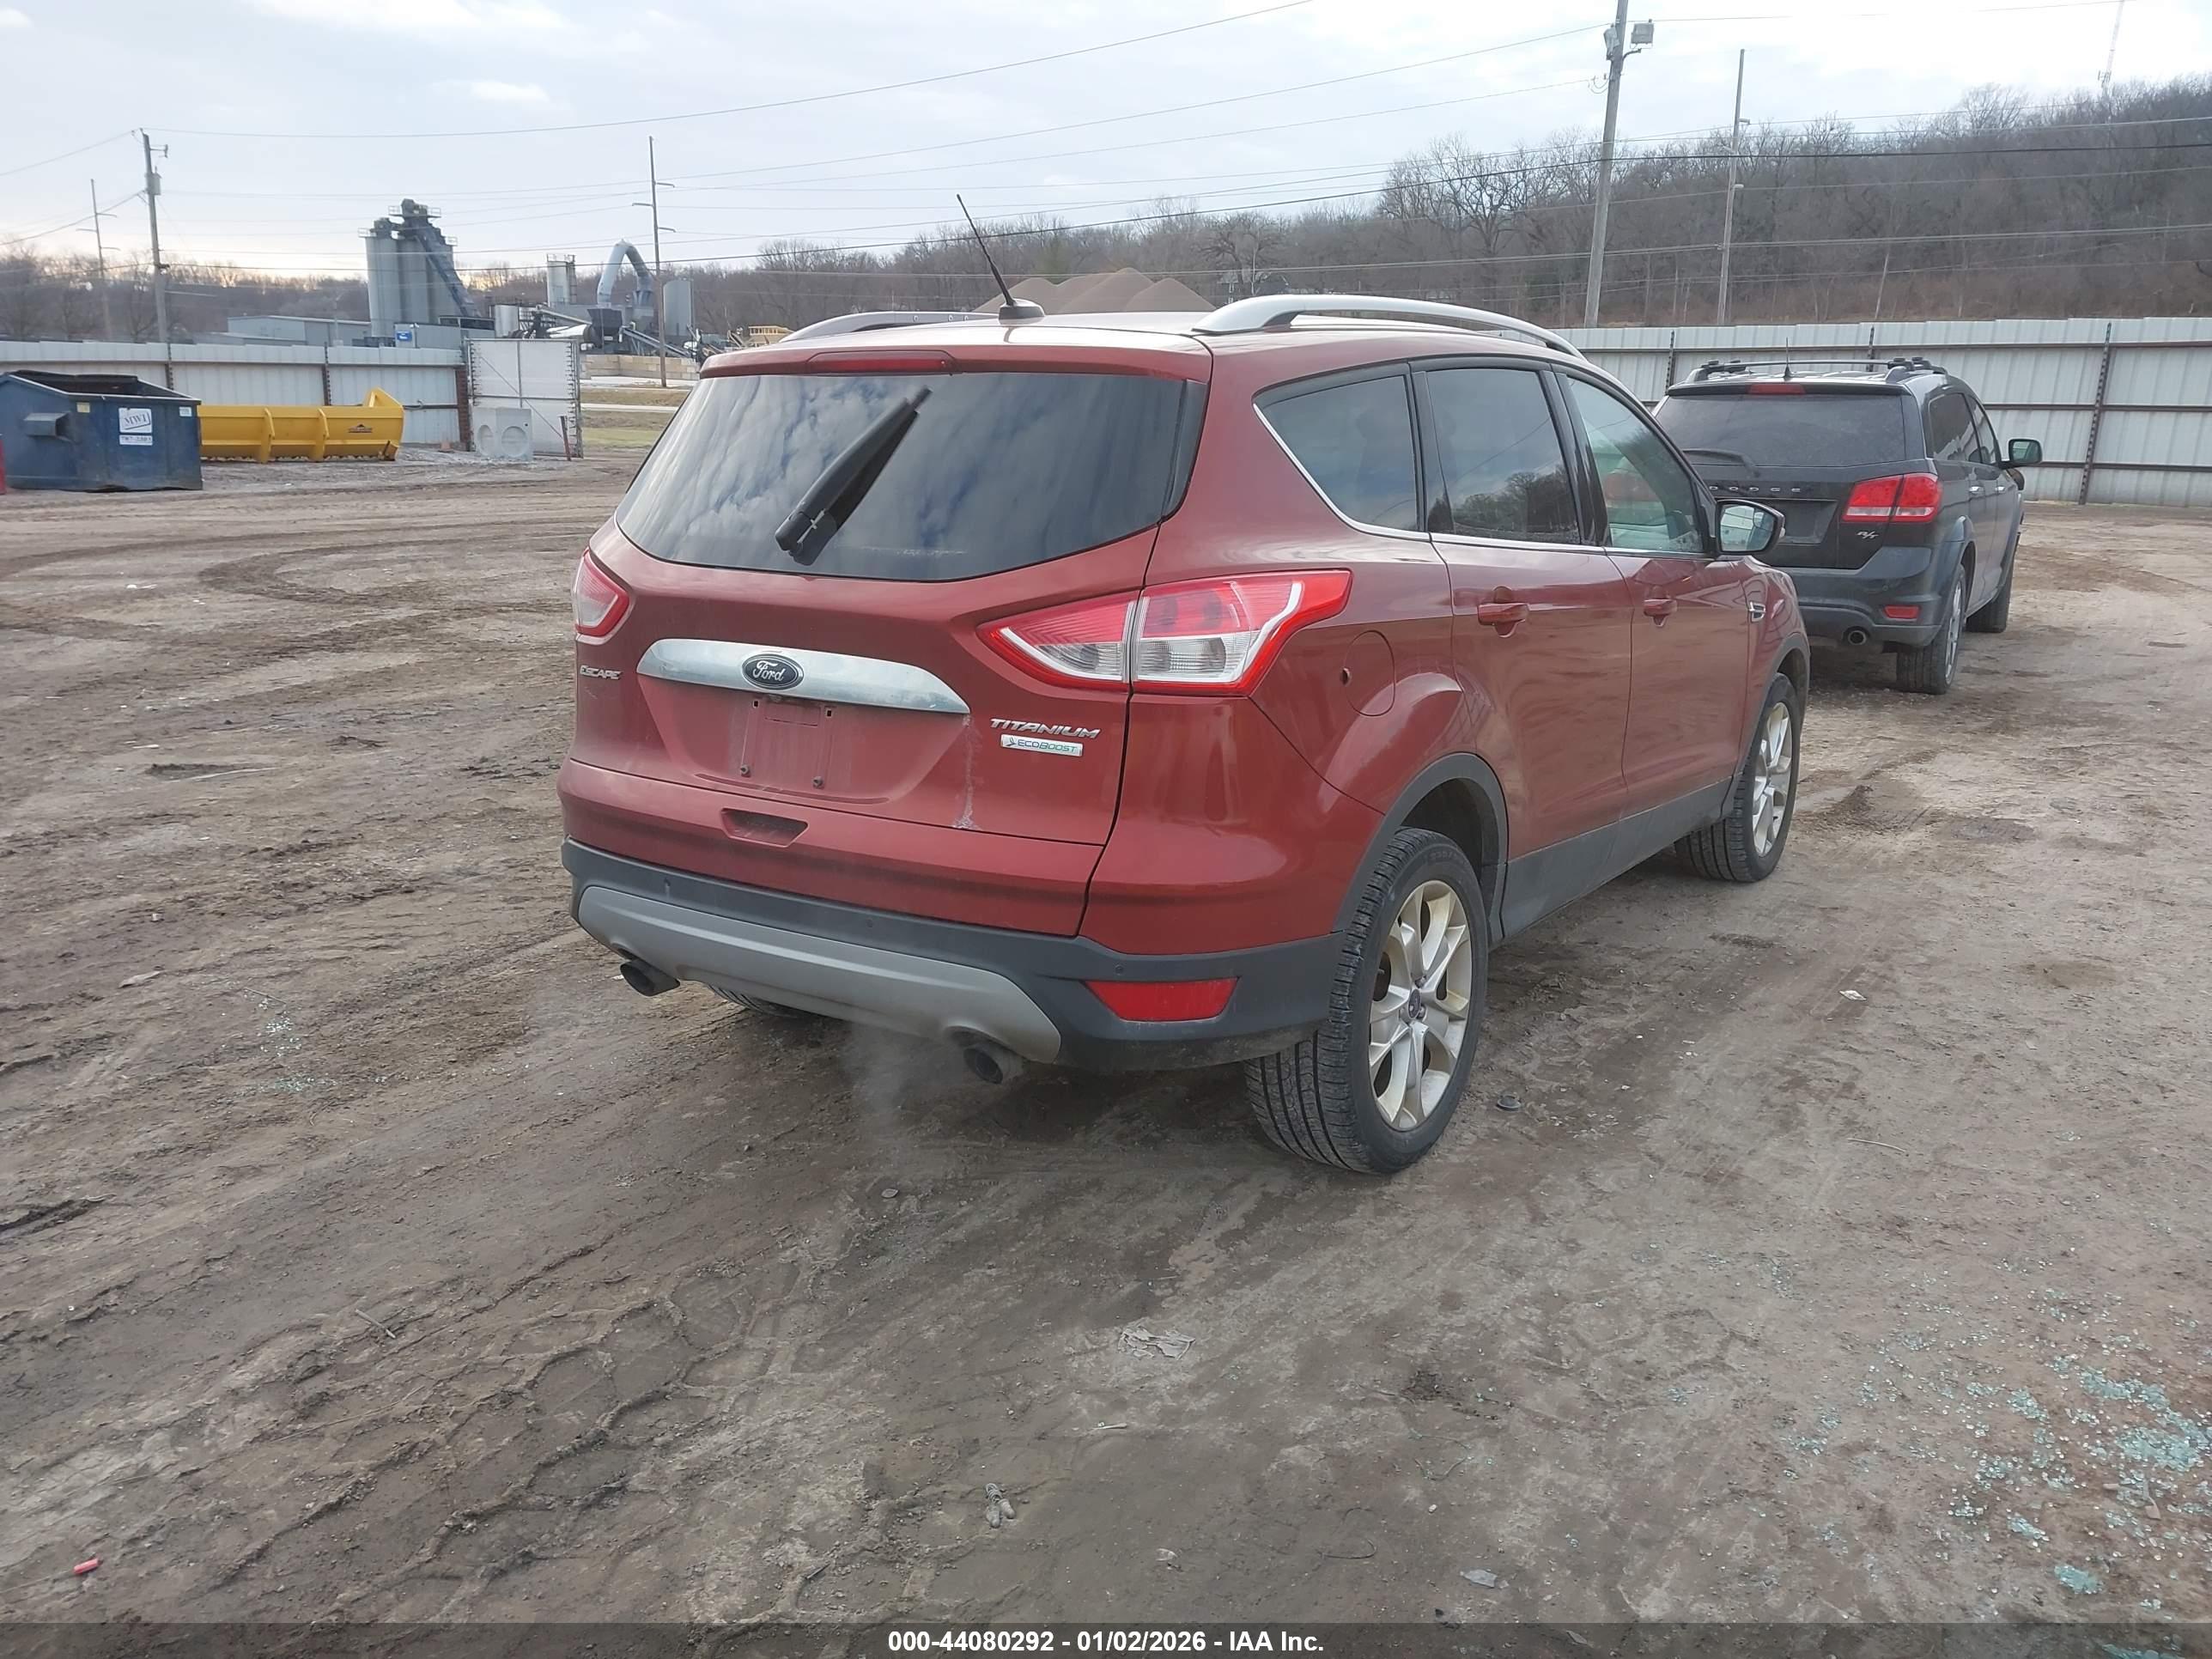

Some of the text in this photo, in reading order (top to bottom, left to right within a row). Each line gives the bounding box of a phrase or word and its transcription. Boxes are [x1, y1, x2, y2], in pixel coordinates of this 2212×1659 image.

[580, 665, 622, 679] ESCAPE
[752, 660, 786, 681] Ford
[990, 718, 1101, 738] TITANIUM
[1018, 738, 1078, 752] ECOBOOST
